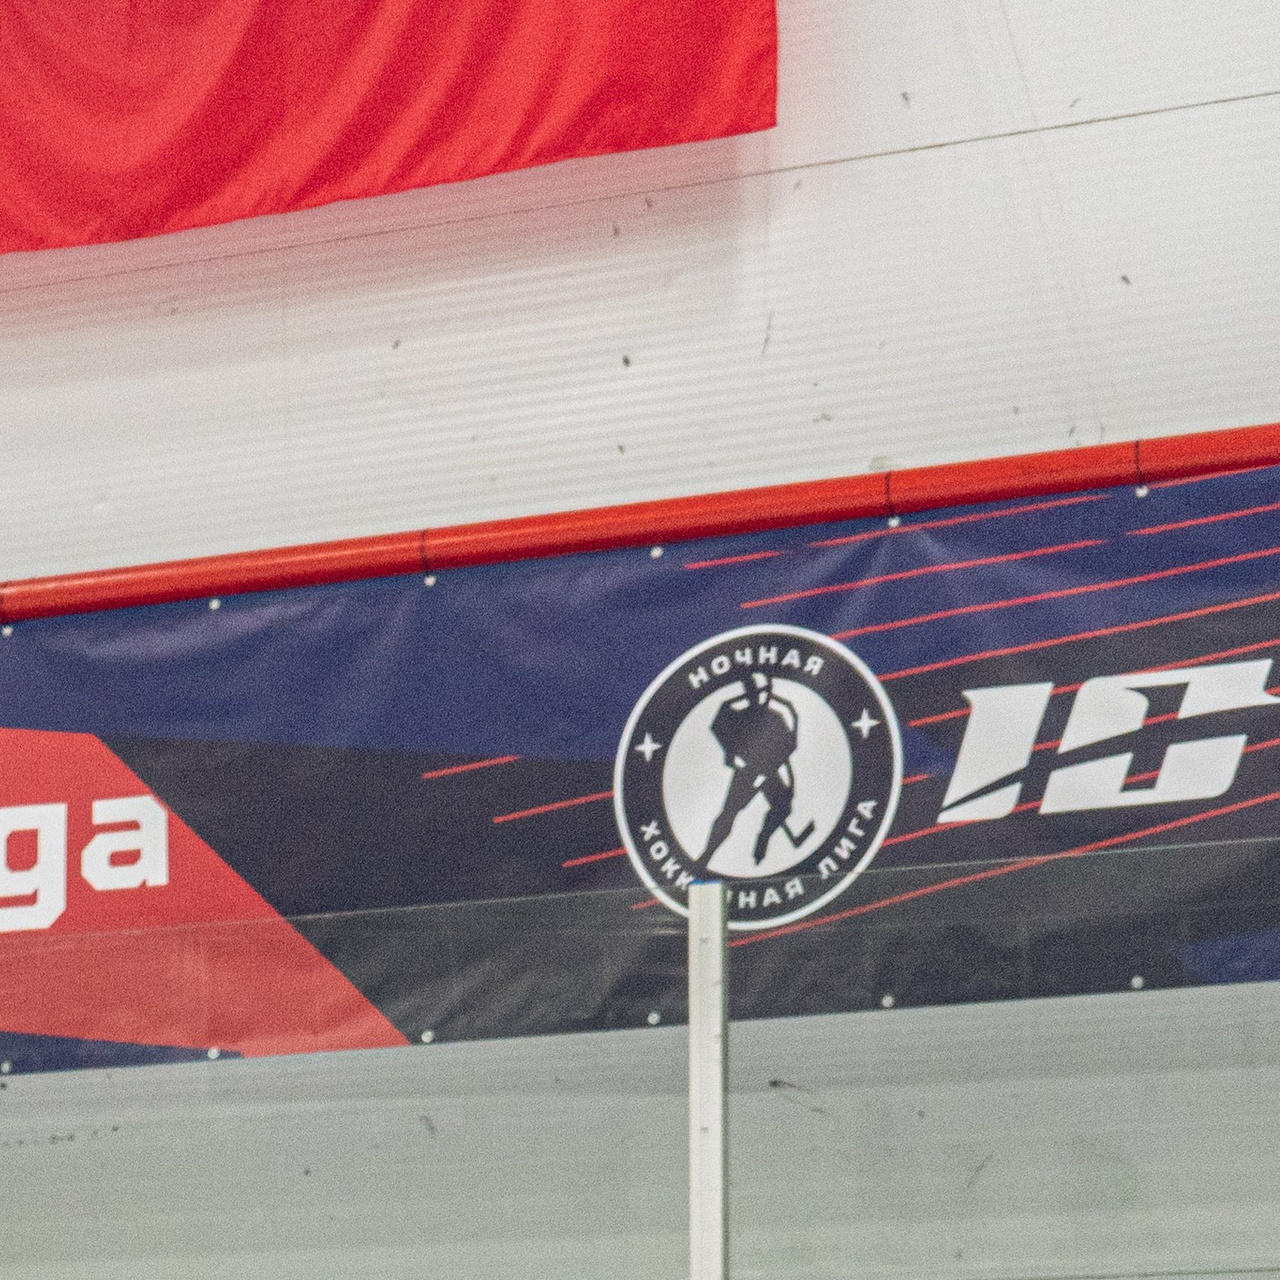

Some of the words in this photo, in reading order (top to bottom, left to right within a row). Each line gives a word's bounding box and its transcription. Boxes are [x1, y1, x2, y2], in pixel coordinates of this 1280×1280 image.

[688, 645, 825, 690] НОЧНАЯ
[639, 819, 806, 910] ХОККНАЯ
[818, 798, 879, 881] ЛИГА
